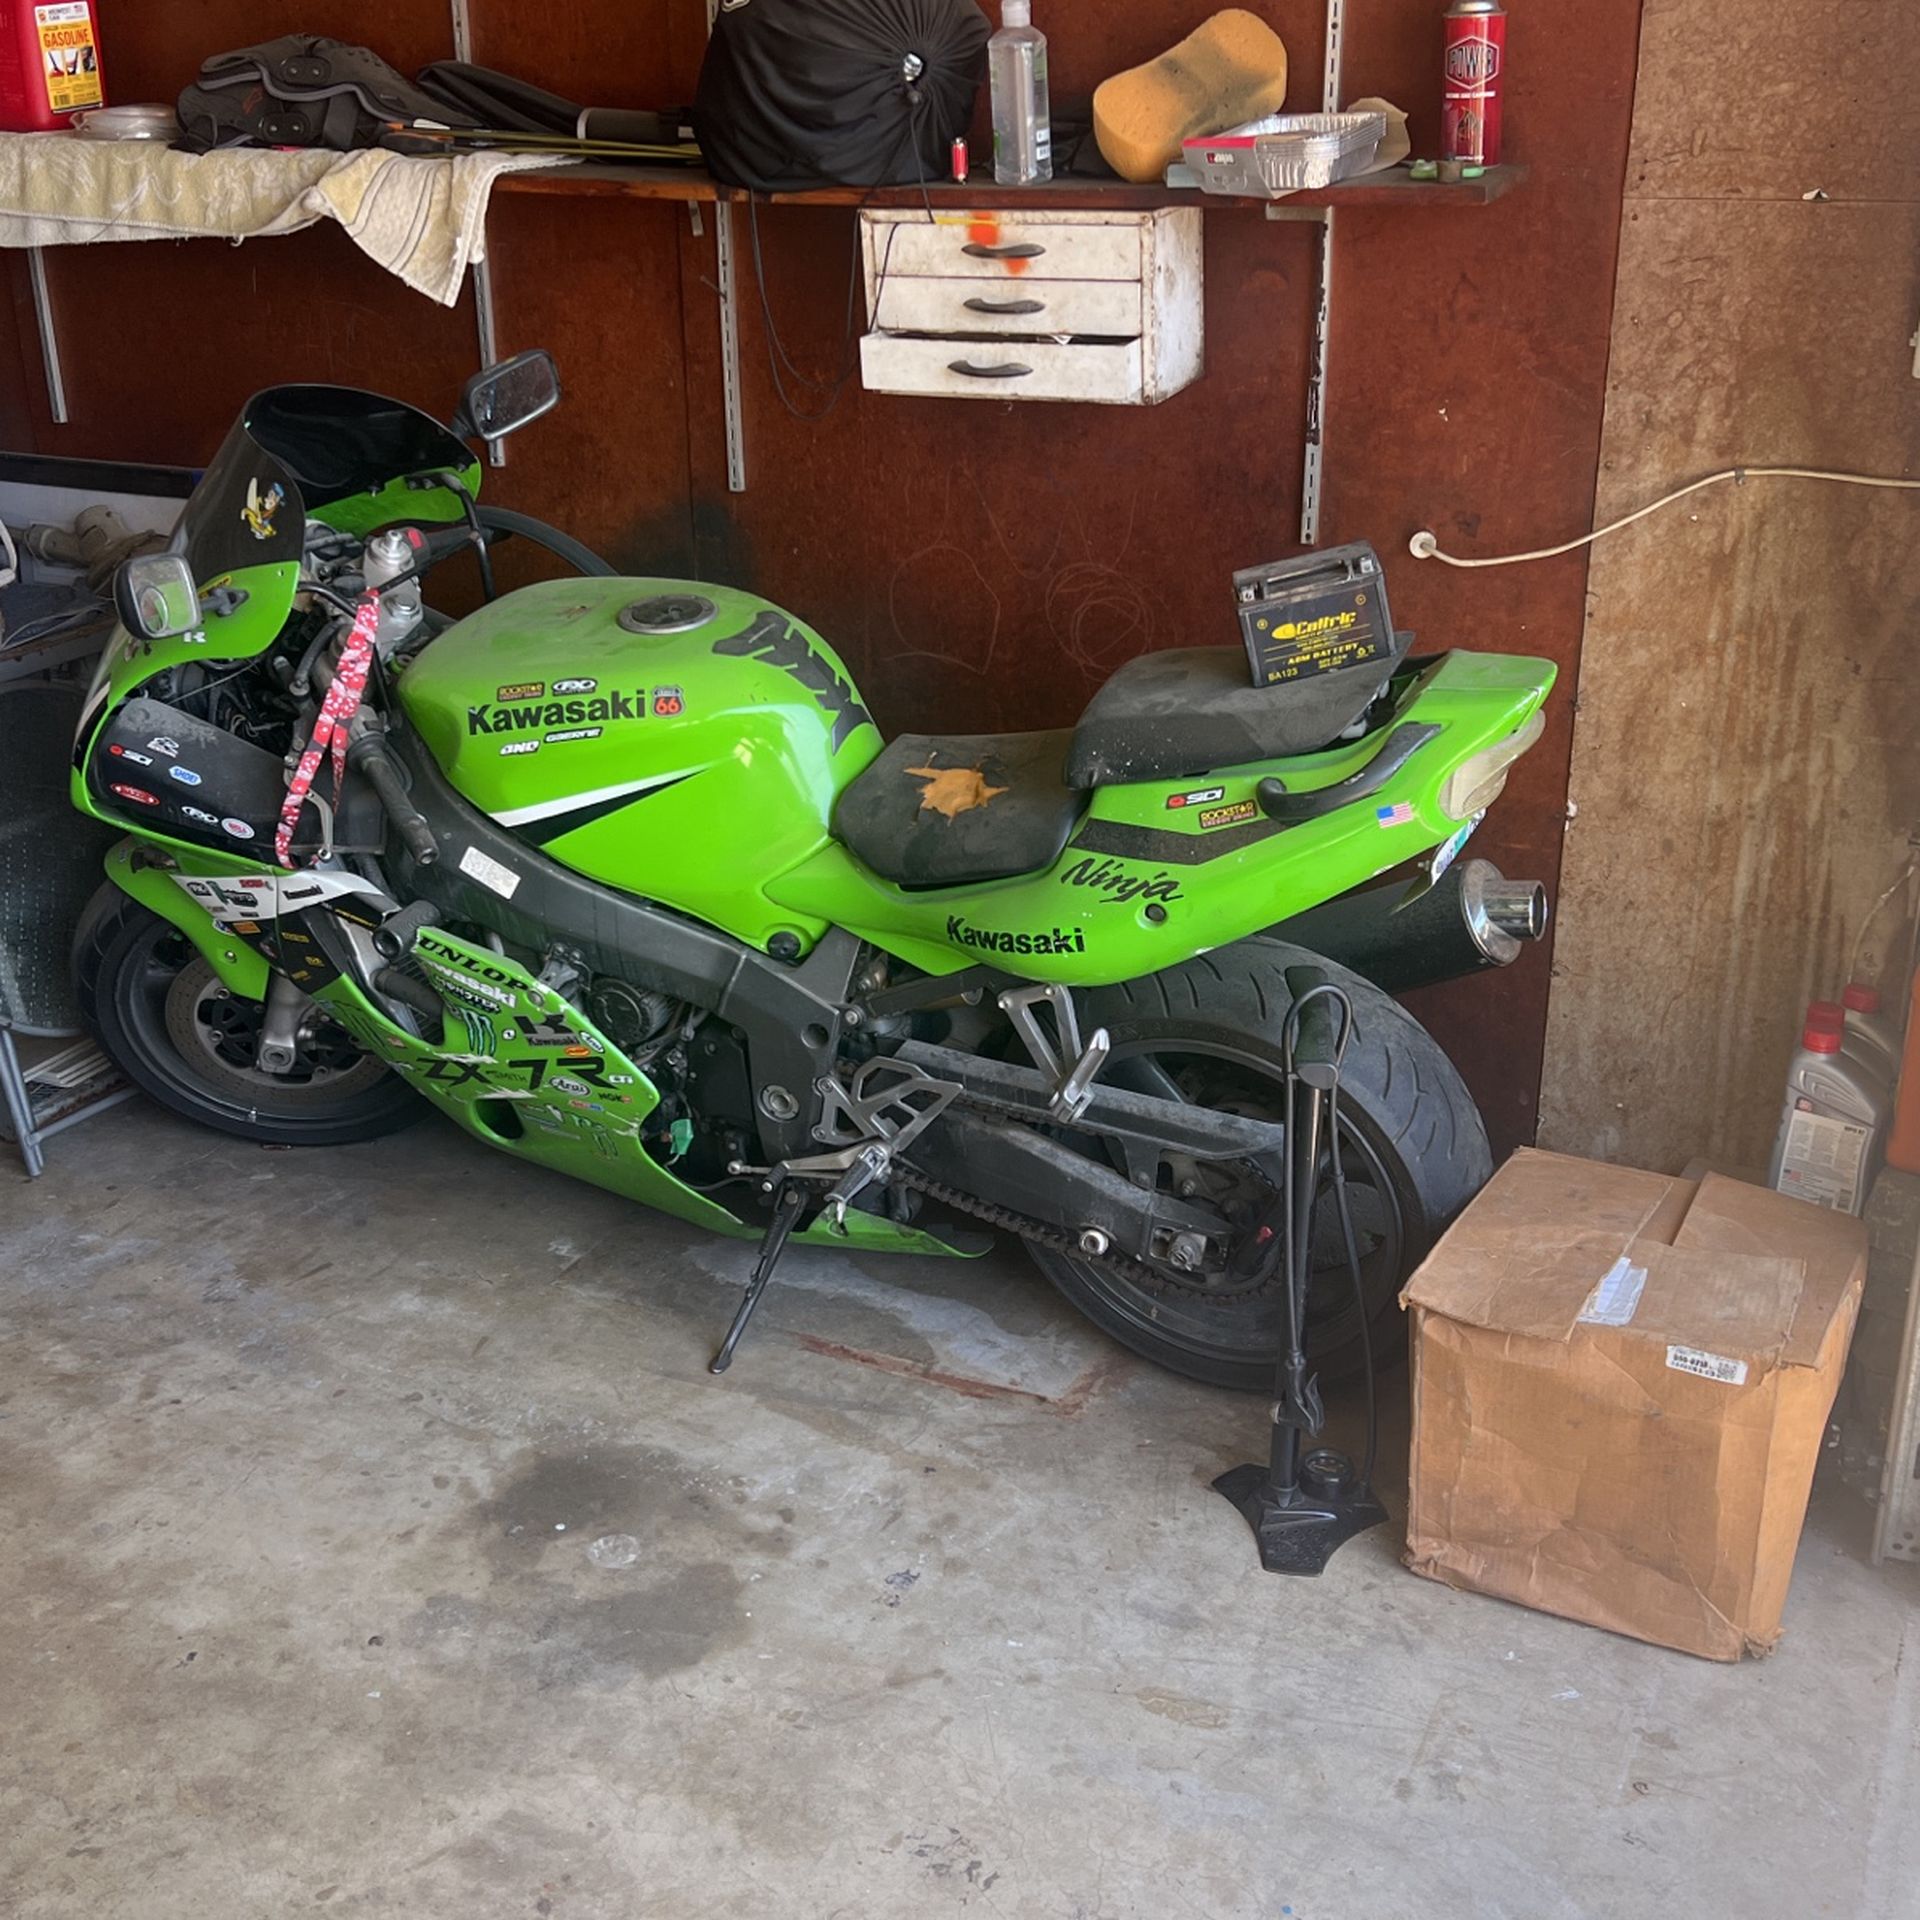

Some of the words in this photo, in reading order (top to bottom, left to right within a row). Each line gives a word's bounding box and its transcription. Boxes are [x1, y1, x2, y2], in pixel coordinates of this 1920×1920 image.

[43, 28, 90, 48] GASOLINE
[1313, 642, 1360, 660] BATTERY
[1268, 667, 1298, 682] BA123
[468, 689, 646, 735] Kawasaki
[656, 697, 680, 714] 66
[1060, 858, 1184, 903] Ninja
[946, 915, 1086, 955] Kawasaki
[418, 936, 529, 991] UNLOP
[556, 1078, 587, 1094] Arai
